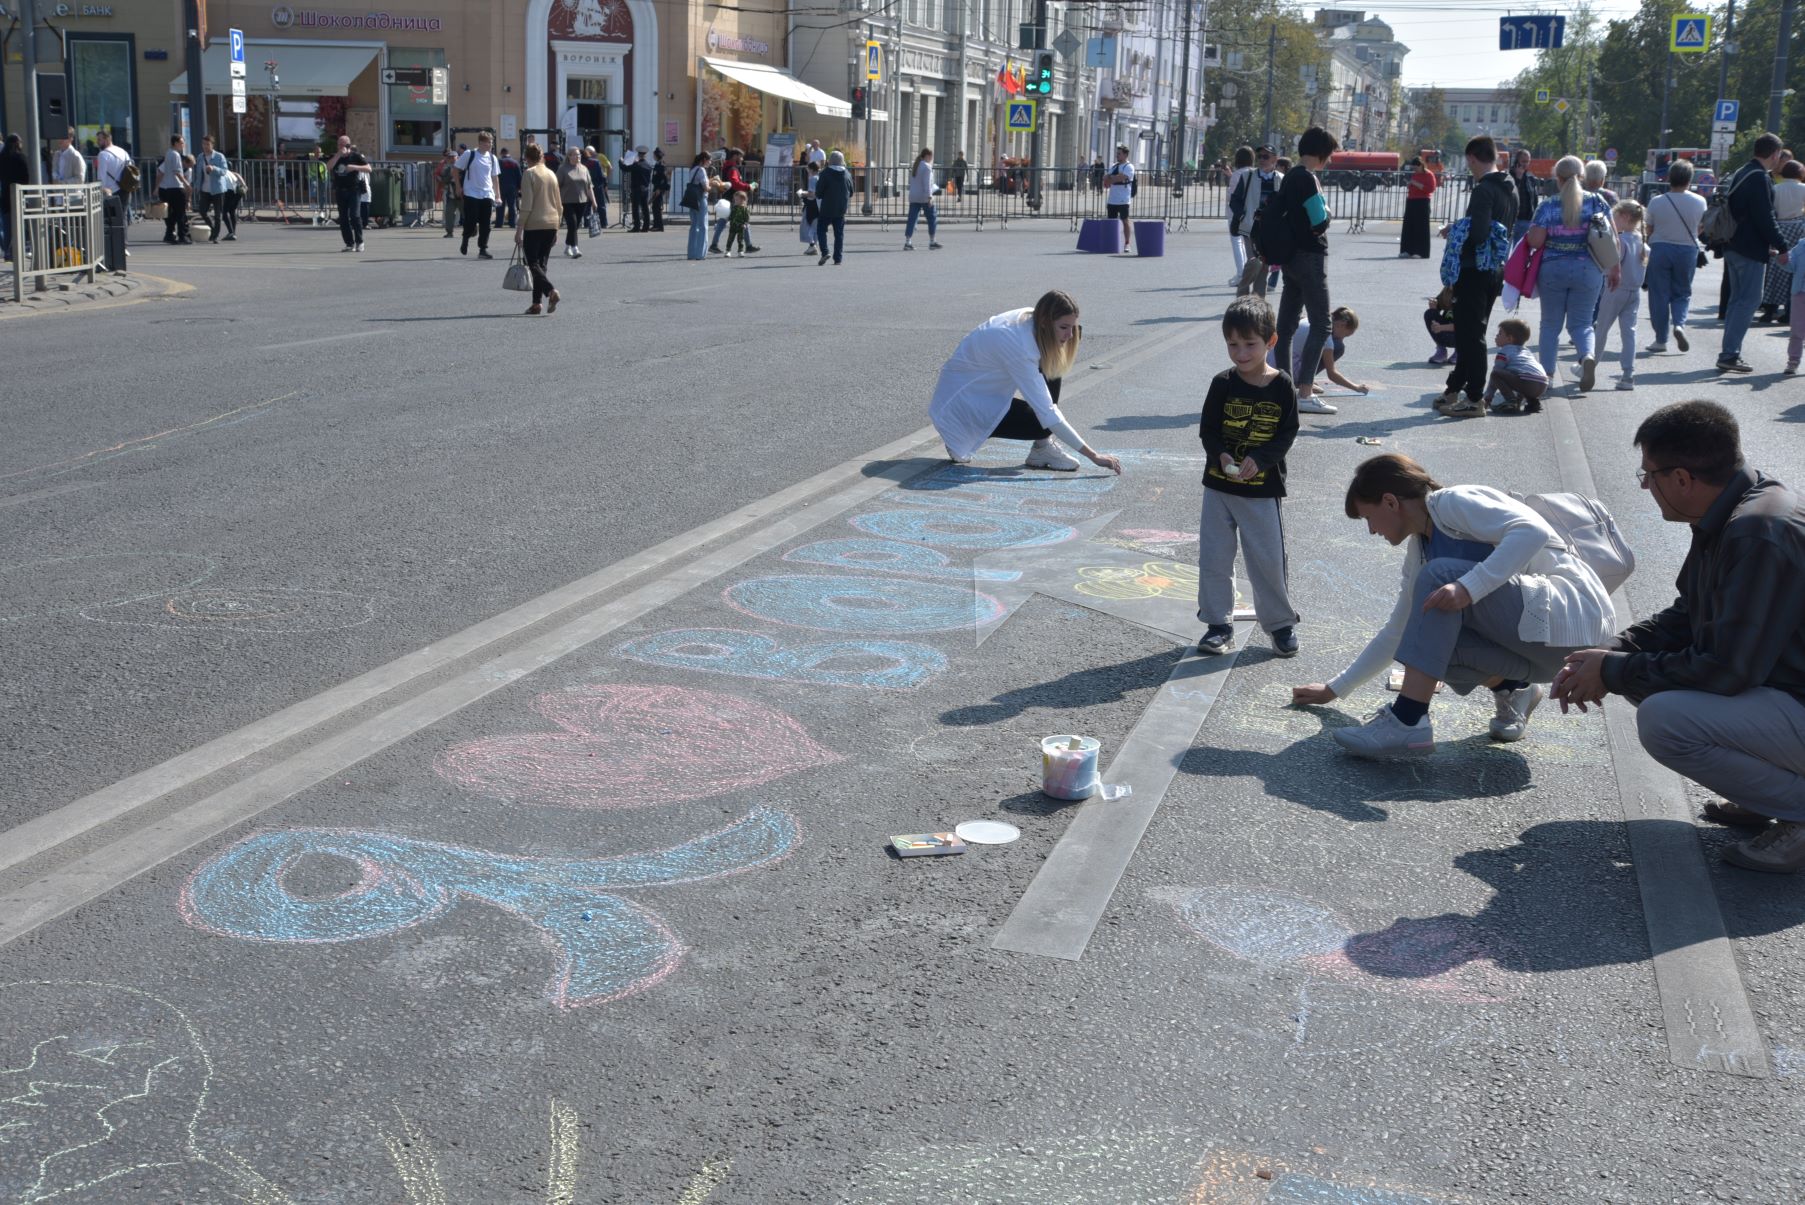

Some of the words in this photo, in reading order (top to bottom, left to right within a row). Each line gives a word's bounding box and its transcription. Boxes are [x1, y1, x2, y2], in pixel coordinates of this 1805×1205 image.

[82, 5, 113, 17] БАНК
[299, 11, 442, 32] Шоколадница
[563, 54, 617, 64] ВОРОНЕЖ
